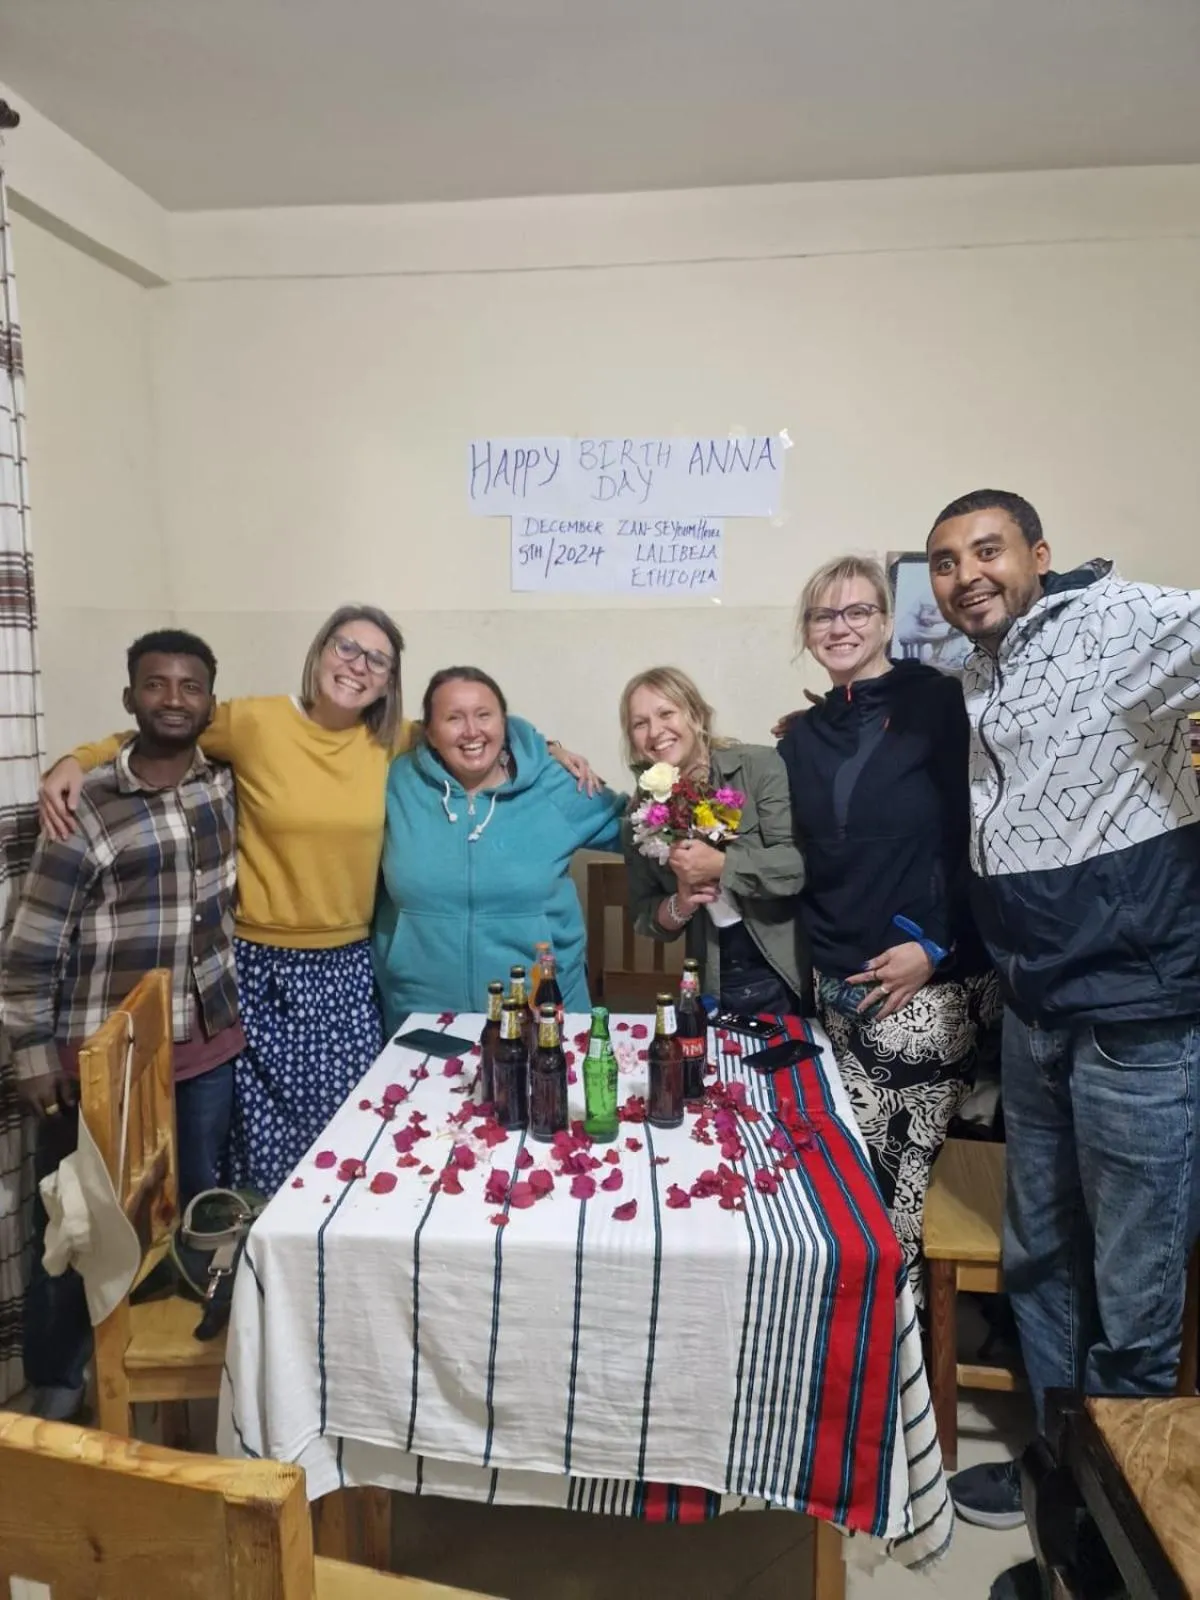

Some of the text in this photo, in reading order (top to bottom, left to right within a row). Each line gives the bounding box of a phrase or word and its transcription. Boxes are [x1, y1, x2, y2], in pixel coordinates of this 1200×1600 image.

[470, 436, 777, 500] HAPPY BIRTH ANNA
[591, 466, 653, 505] DAY
[520, 516, 605, 537] DECEMBER
[635, 543, 718, 563] LALIBELA
[630, 566, 718, 589] ETHIOPIA
